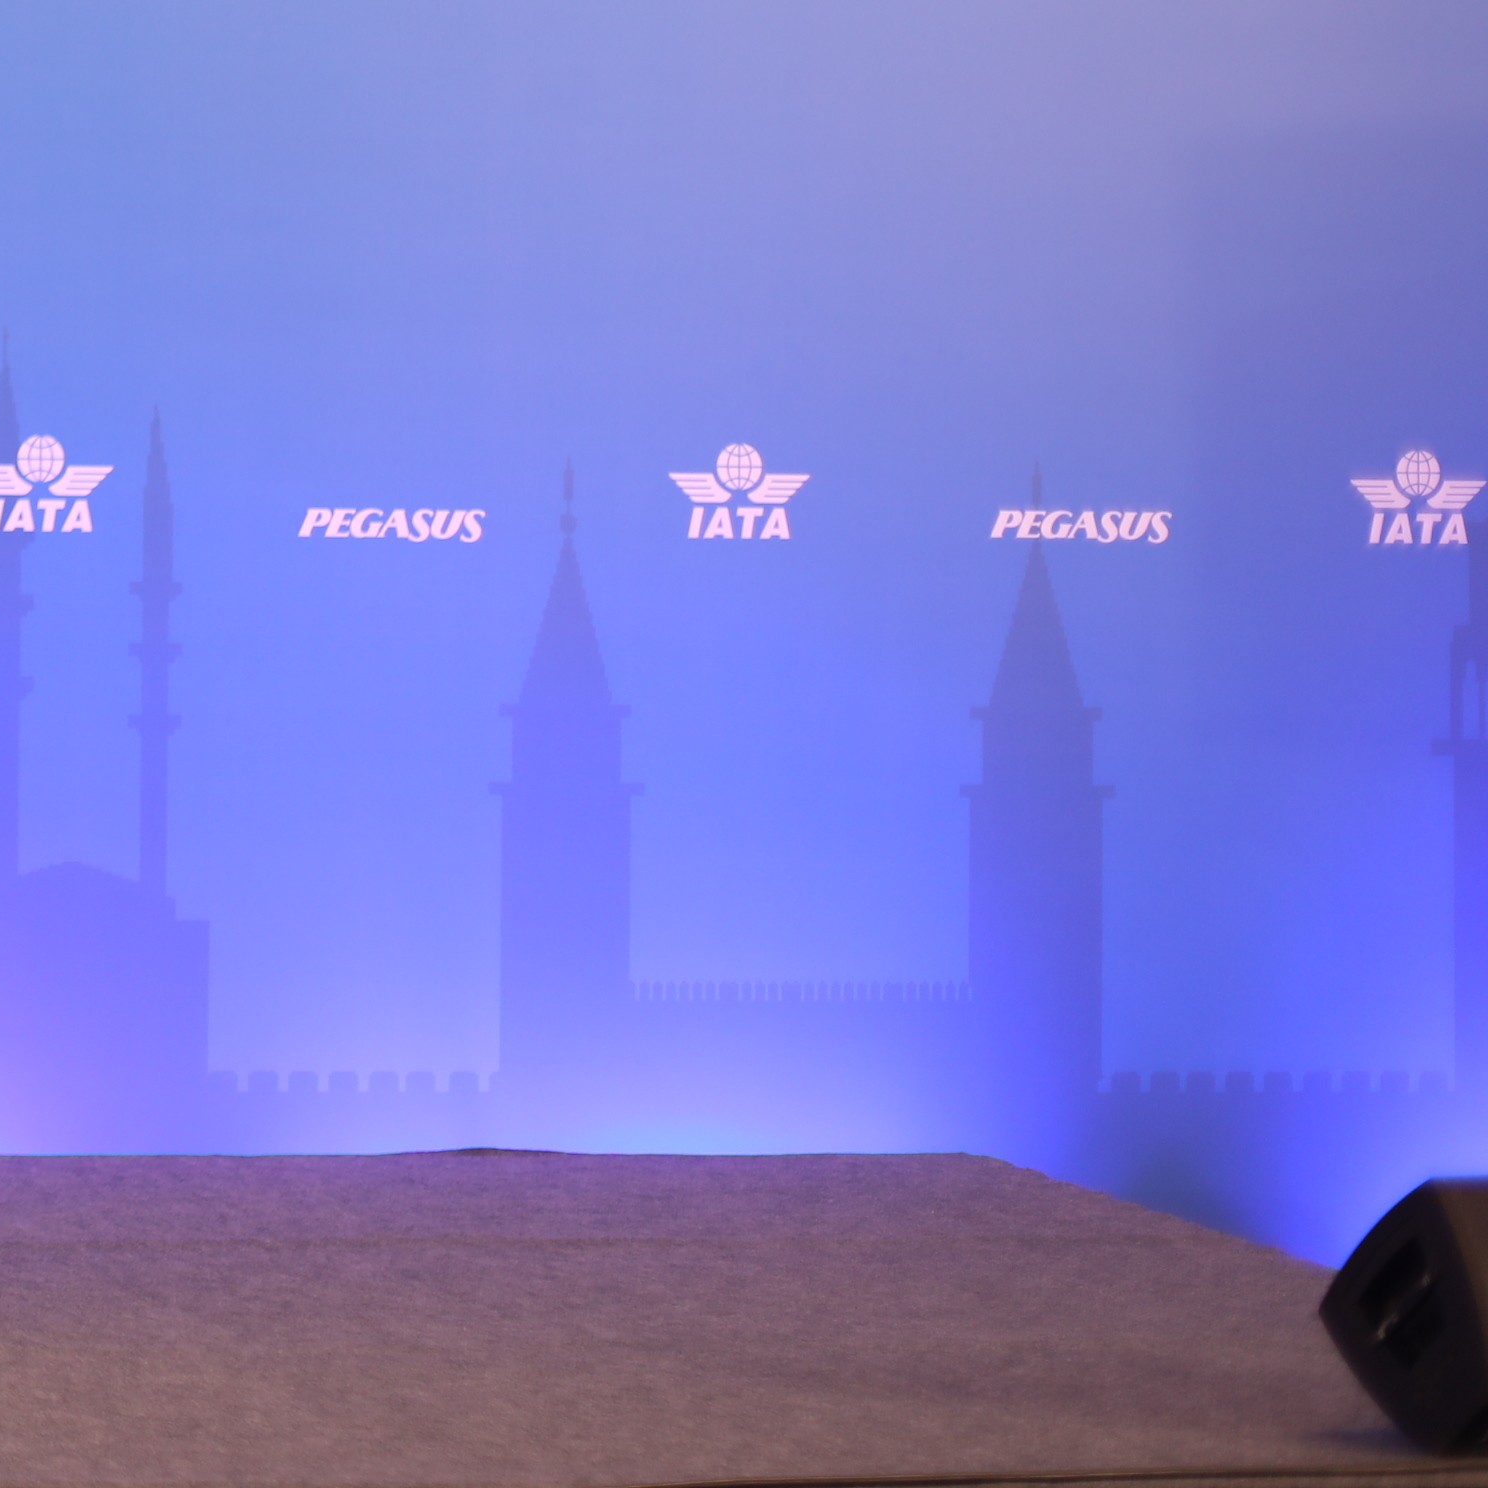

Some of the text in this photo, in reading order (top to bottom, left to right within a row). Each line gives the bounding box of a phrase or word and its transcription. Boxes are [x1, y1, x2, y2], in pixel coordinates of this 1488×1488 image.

[299, 509, 485, 542] PEGASUS
[688, 507, 789, 539] IATA
[991, 510, 1172, 543] PEGASUS
[1369, 511, 1467, 544] IATA
